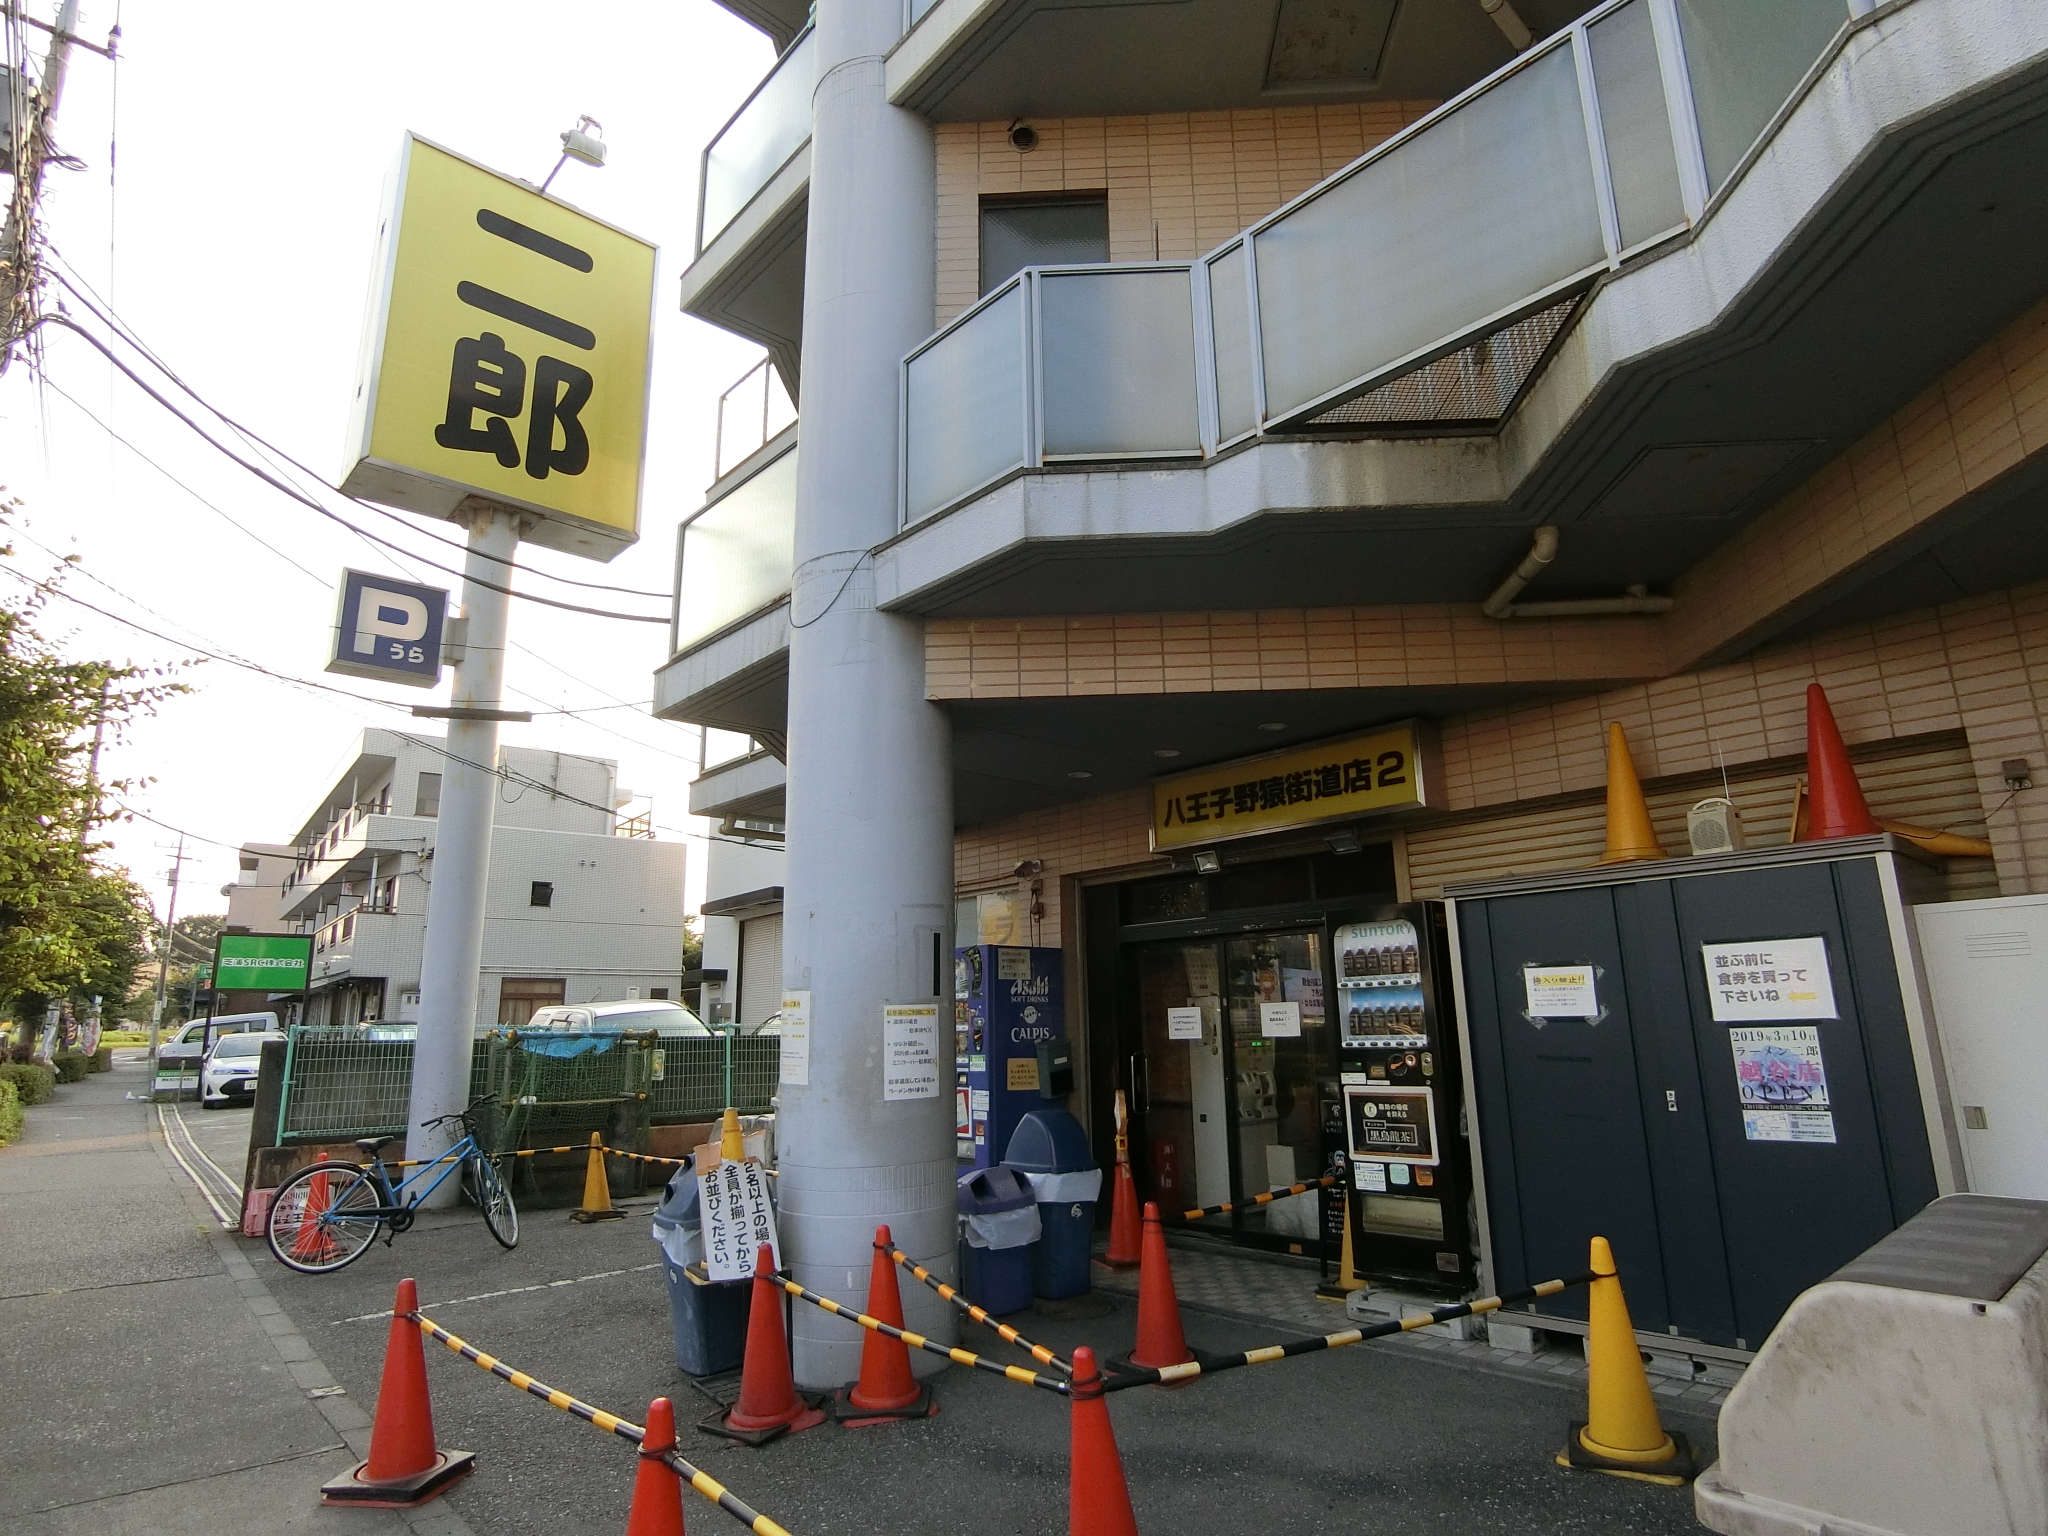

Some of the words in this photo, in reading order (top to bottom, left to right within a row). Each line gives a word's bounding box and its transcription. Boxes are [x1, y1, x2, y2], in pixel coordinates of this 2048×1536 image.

[352, 585, 429, 656] P
[390, 641, 425, 664] うら
[1163, 750, 1406, 828] 八王子野猿街道店2
[1352, 923, 1412, 938] SUNTORY
[1714, 952, 1774, 968] 並ぶ前に
[1010, 975, 1049, 996] Asahi
[1717, 969, 1807, 986] 食券を買って
[1010, 995, 1026, 1003] SOFT
[1027, 995, 1049, 1003] DRINKS
[1720, 989, 1780, 1003] 下さいね
[1010, 1027, 1050, 1043] CALPIS
[1732, 1029, 1816, 1042] 2019年3月10日
[1736, 1045, 1819, 1057] ラーメン二郎
[1738, 1060, 1821, 1082] 越谷店
[743, 1162, 770, 1244] 2名以上の場
[704, 1169, 730, 1269] お並びください。
